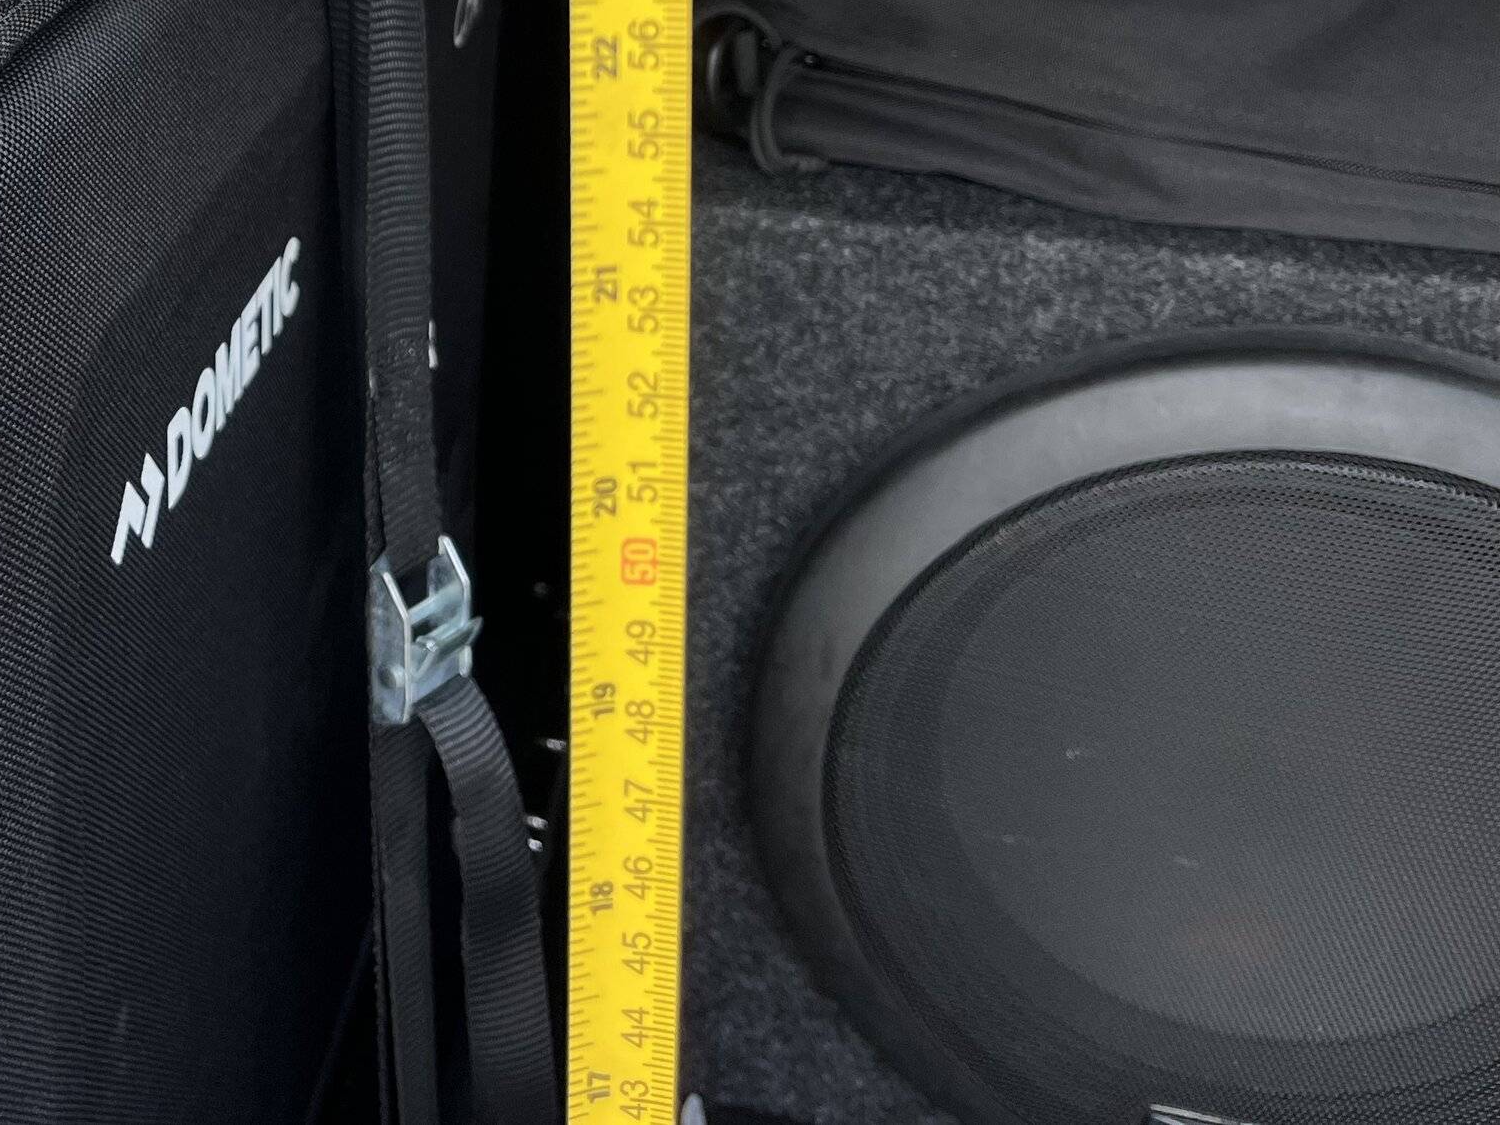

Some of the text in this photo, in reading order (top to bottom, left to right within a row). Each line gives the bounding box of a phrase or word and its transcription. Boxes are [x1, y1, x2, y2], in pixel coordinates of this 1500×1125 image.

[592, 33, 618, 79] 22
[627, 19, 660, 71] 56
[627, 109, 659, 161] 55
[627, 197, 660, 249] 54
[593, 266, 617, 303] 21
[627, 285, 658, 334] 53
[168, 236, 301, 511] DOMETIC
[626, 371, 659, 420] 52
[592, 477, 618, 518] 20
[626, 460, 659, 503] 51
[621, 538, 659, 586] 50
[625, 619, 656, 666] 49
[591, 682, 616, 719] 19
[624, 699, 655, 744] 48
[624, 779, 654, 823] 47
[589, 881, 614, 916] 18
[623, 855, 653, 901] 46
[621, 931, 652, 975] 45
[621, 1007, 650, 1048] 44
[587, 1071, 611, 1104] 17
[619, 1079, 649, 1121] 43
